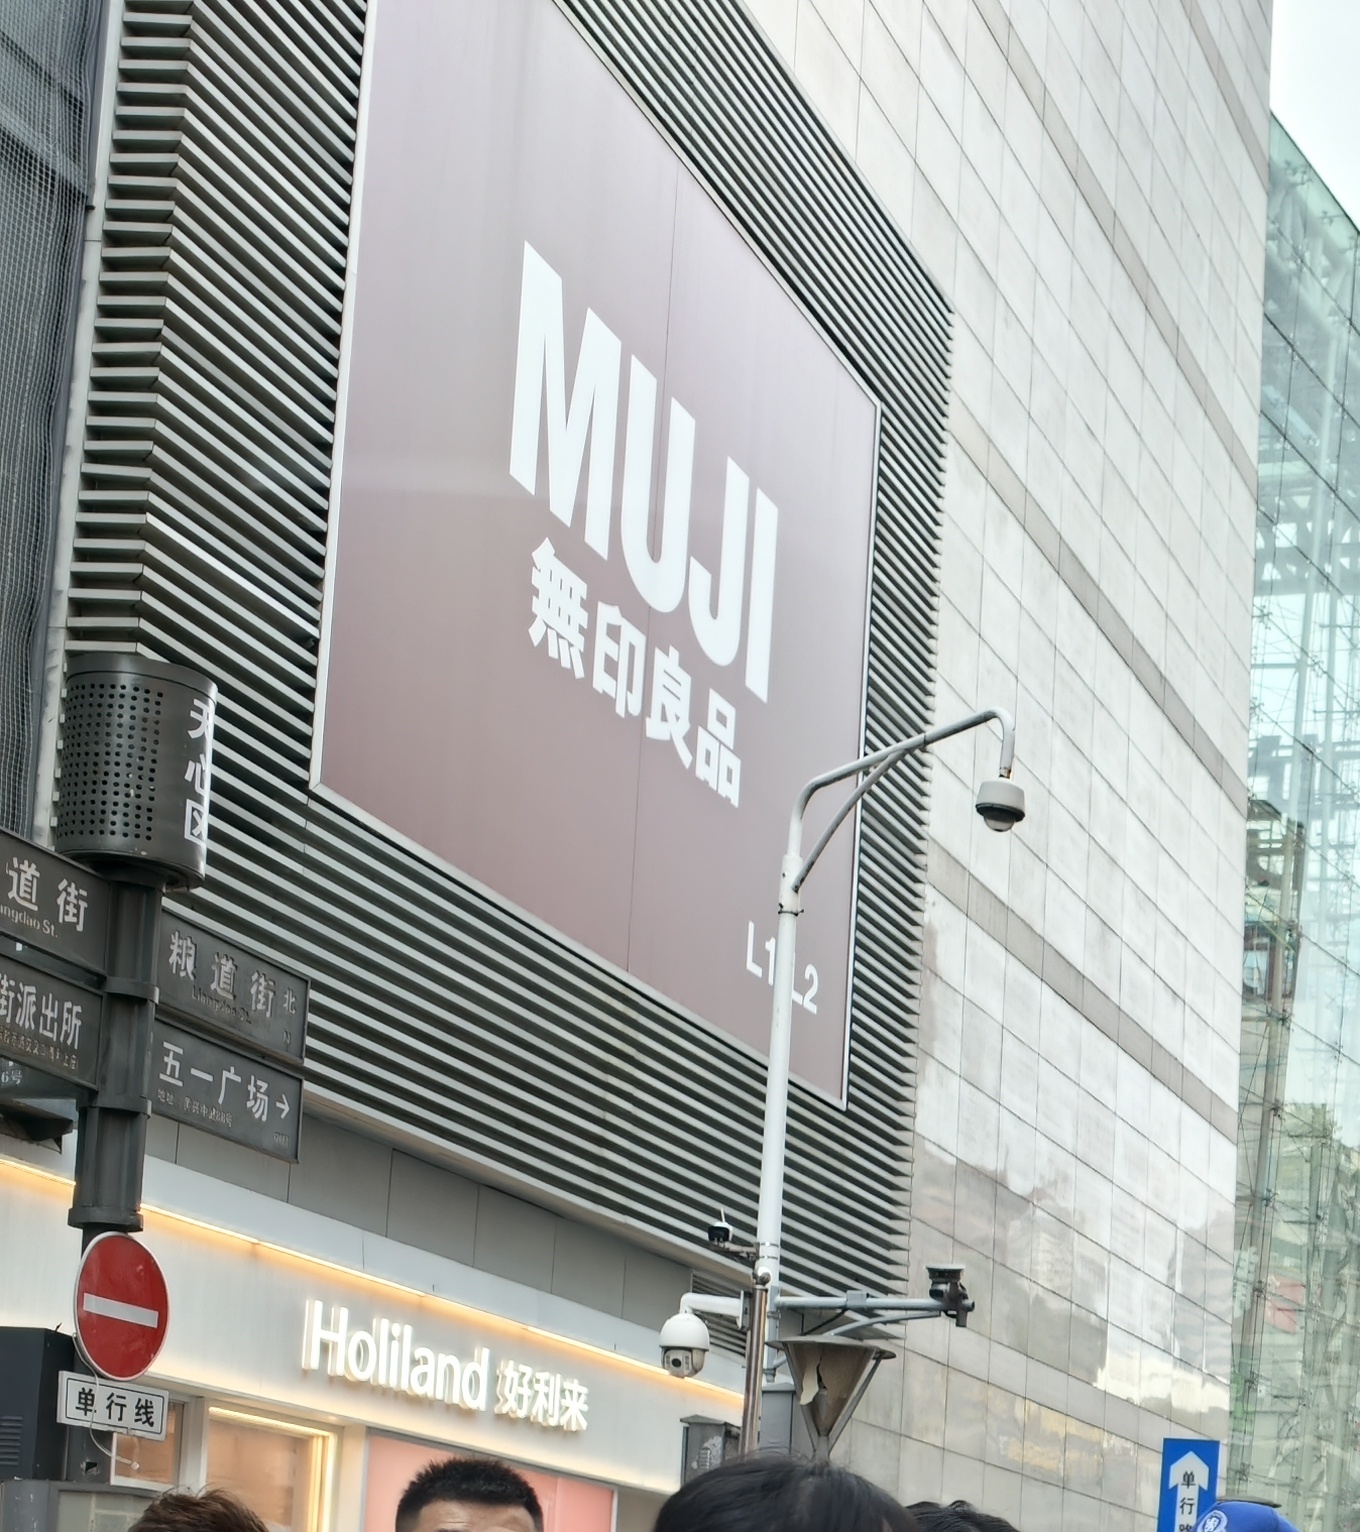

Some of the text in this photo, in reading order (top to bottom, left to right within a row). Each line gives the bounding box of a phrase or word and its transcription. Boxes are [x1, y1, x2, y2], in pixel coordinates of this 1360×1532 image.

[509, 239, 780, 703] MUJI
[529, 537, 741, 808] 無印良品
[184, 698, 215, 845] 天心区
[5, 857, 89, 933] 道街
[0, 972, 83, 1051] 街派出所
[168, 930, 297, 1019] 粮道街 北
[746, 920, 820, 1016] L1L2
[158, 1041, 270, 1123] 五一广场
[74, 1387, 156, 1429] 单行线
[302, 1299, 589, 1434] Holiland 好利来
